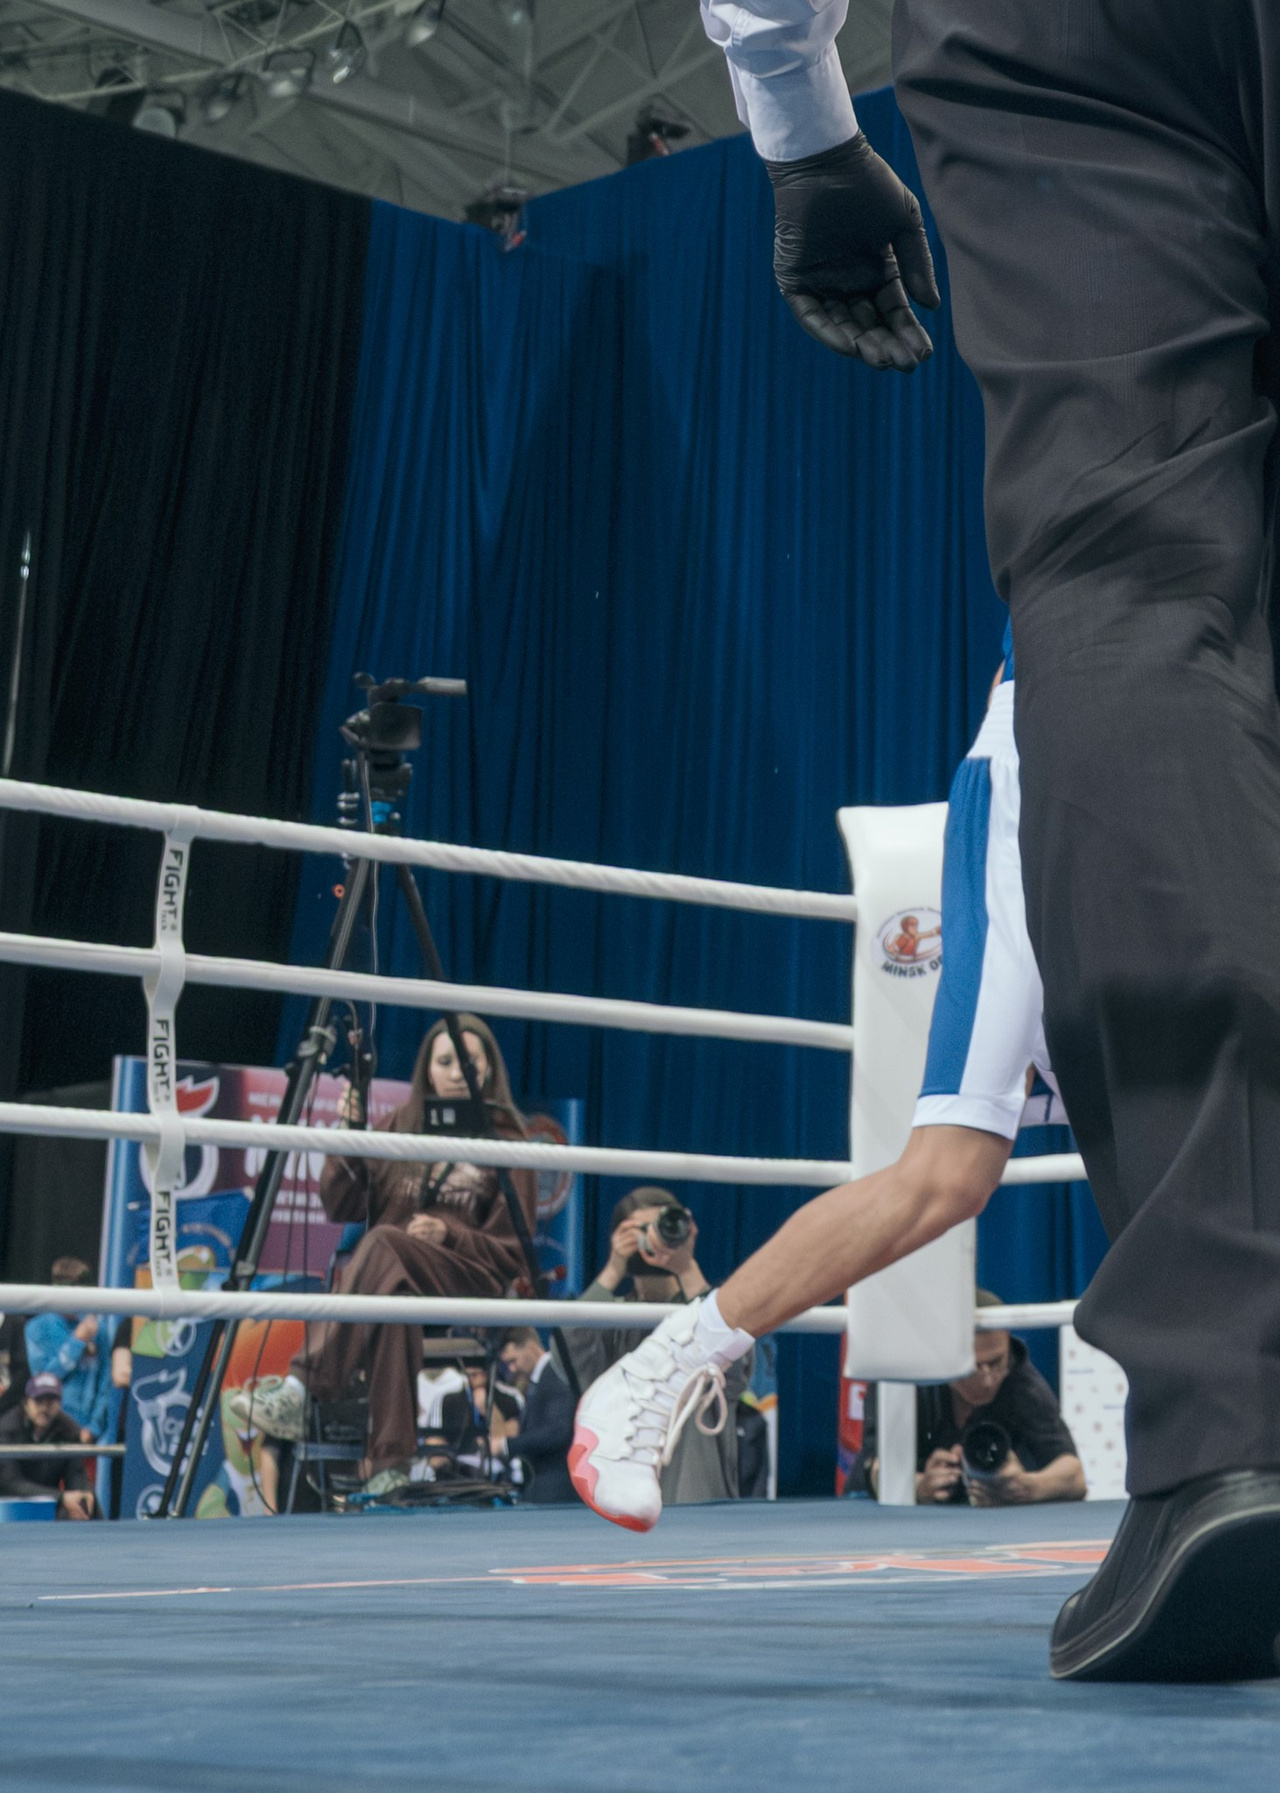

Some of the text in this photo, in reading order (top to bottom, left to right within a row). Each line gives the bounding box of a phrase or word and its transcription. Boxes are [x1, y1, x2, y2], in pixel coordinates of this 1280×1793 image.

[162, 849, 184, 919] FIGHT
[881, 960, 928, 978] MINSK
[153, 1019, 170, 1090] FIGHT
[155, 1191, 171, 1264] FIGHT
